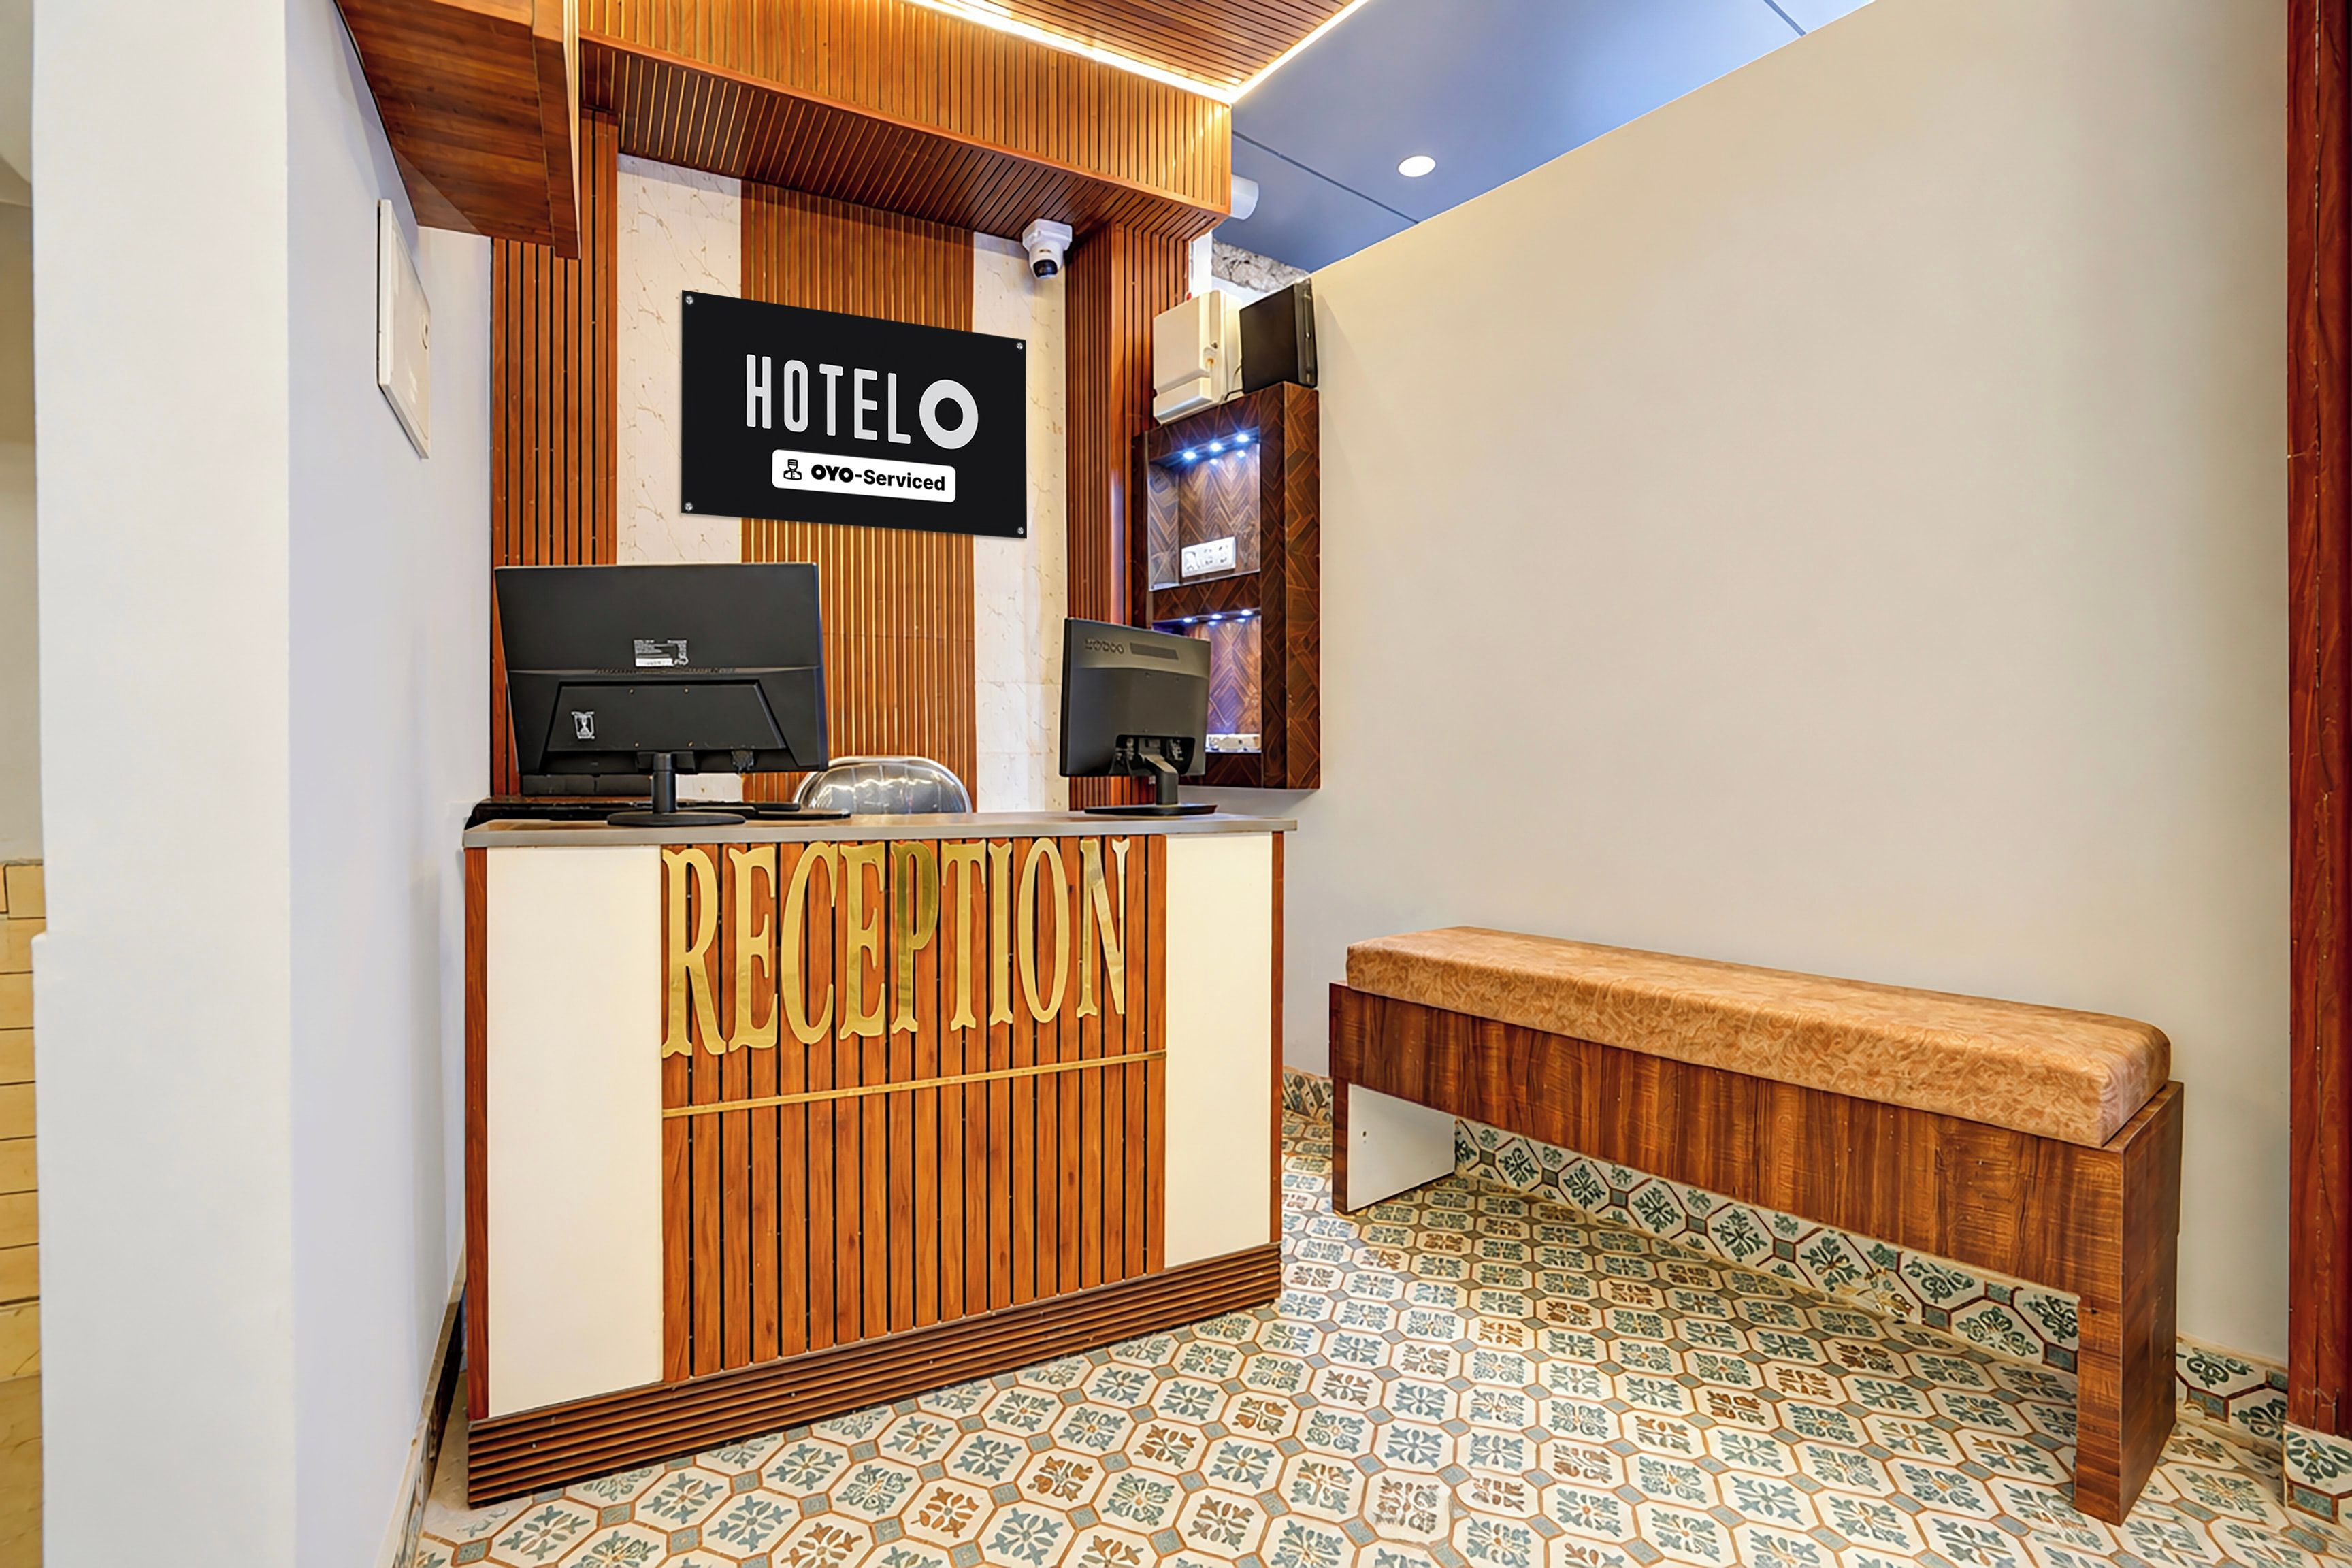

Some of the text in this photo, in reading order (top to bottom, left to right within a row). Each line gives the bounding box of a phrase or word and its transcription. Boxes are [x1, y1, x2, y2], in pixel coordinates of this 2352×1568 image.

[746, 353, 911, 444] HOTEL
[811, 464, 945, 491] OYO-Serviced
[662, 838, 1127, 1058] RECEPTION
